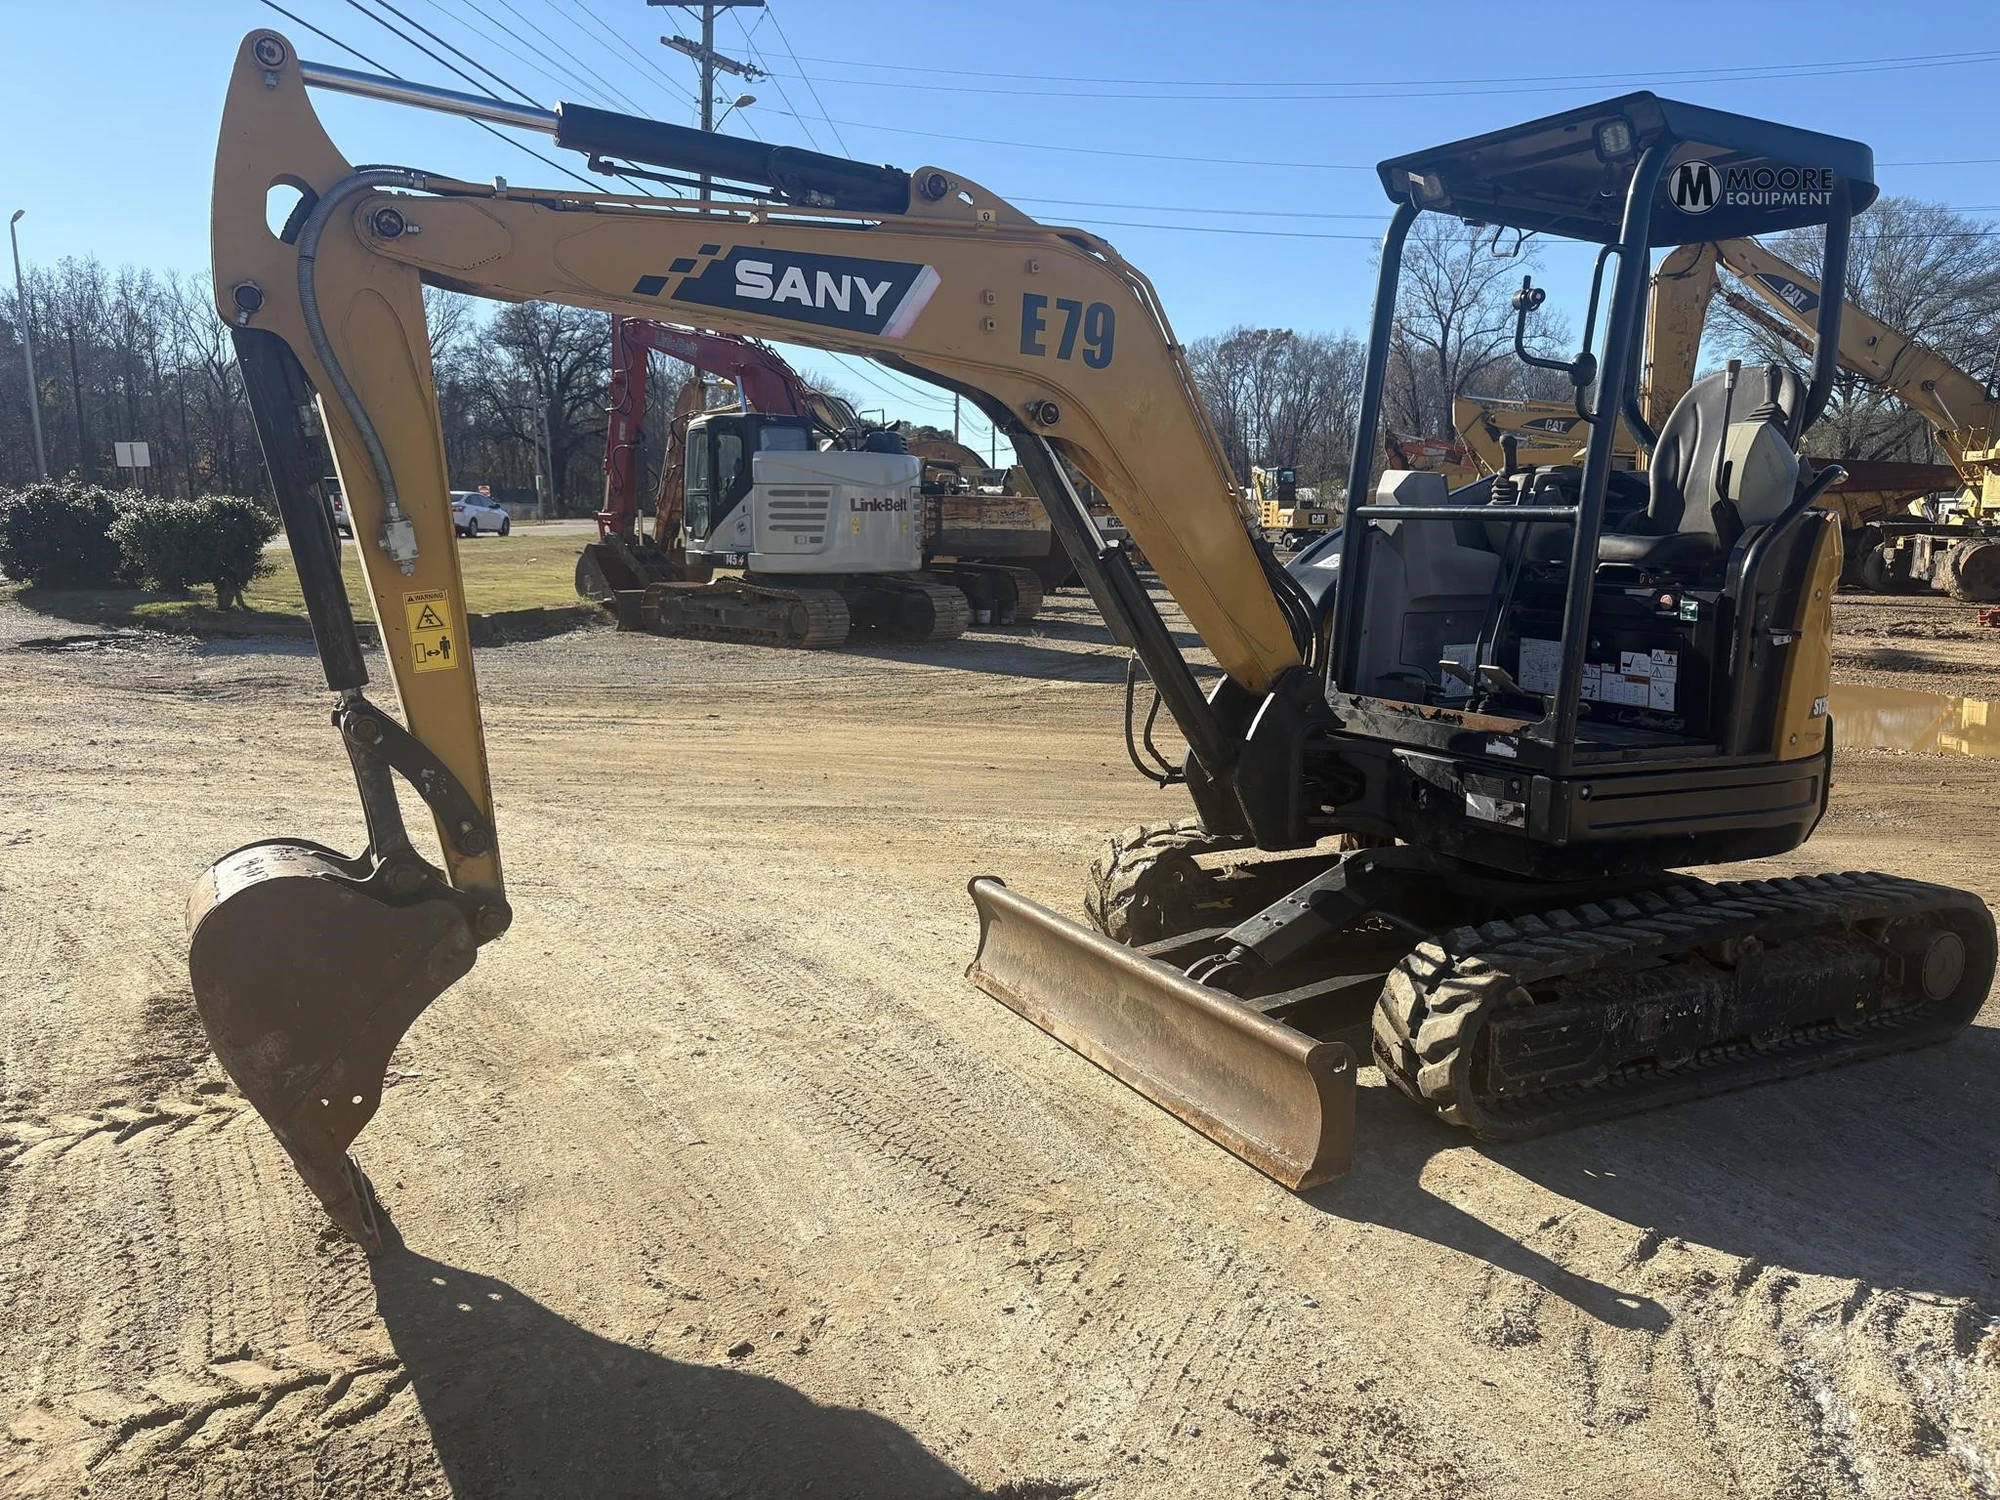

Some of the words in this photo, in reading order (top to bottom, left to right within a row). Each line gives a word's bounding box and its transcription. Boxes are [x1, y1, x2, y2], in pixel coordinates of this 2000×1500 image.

[735, 259, 892, 316] SANY
[1780, 282, 1808, 308] CAT
[1020, 292, 1115, 369] E79
[1545, 419, 1566, 432] CAT
[850, 497, 907, 512] Link-Belt
[1311, 514, 1325, 524] CAT
[414, 592, 444, 601] WARNING
